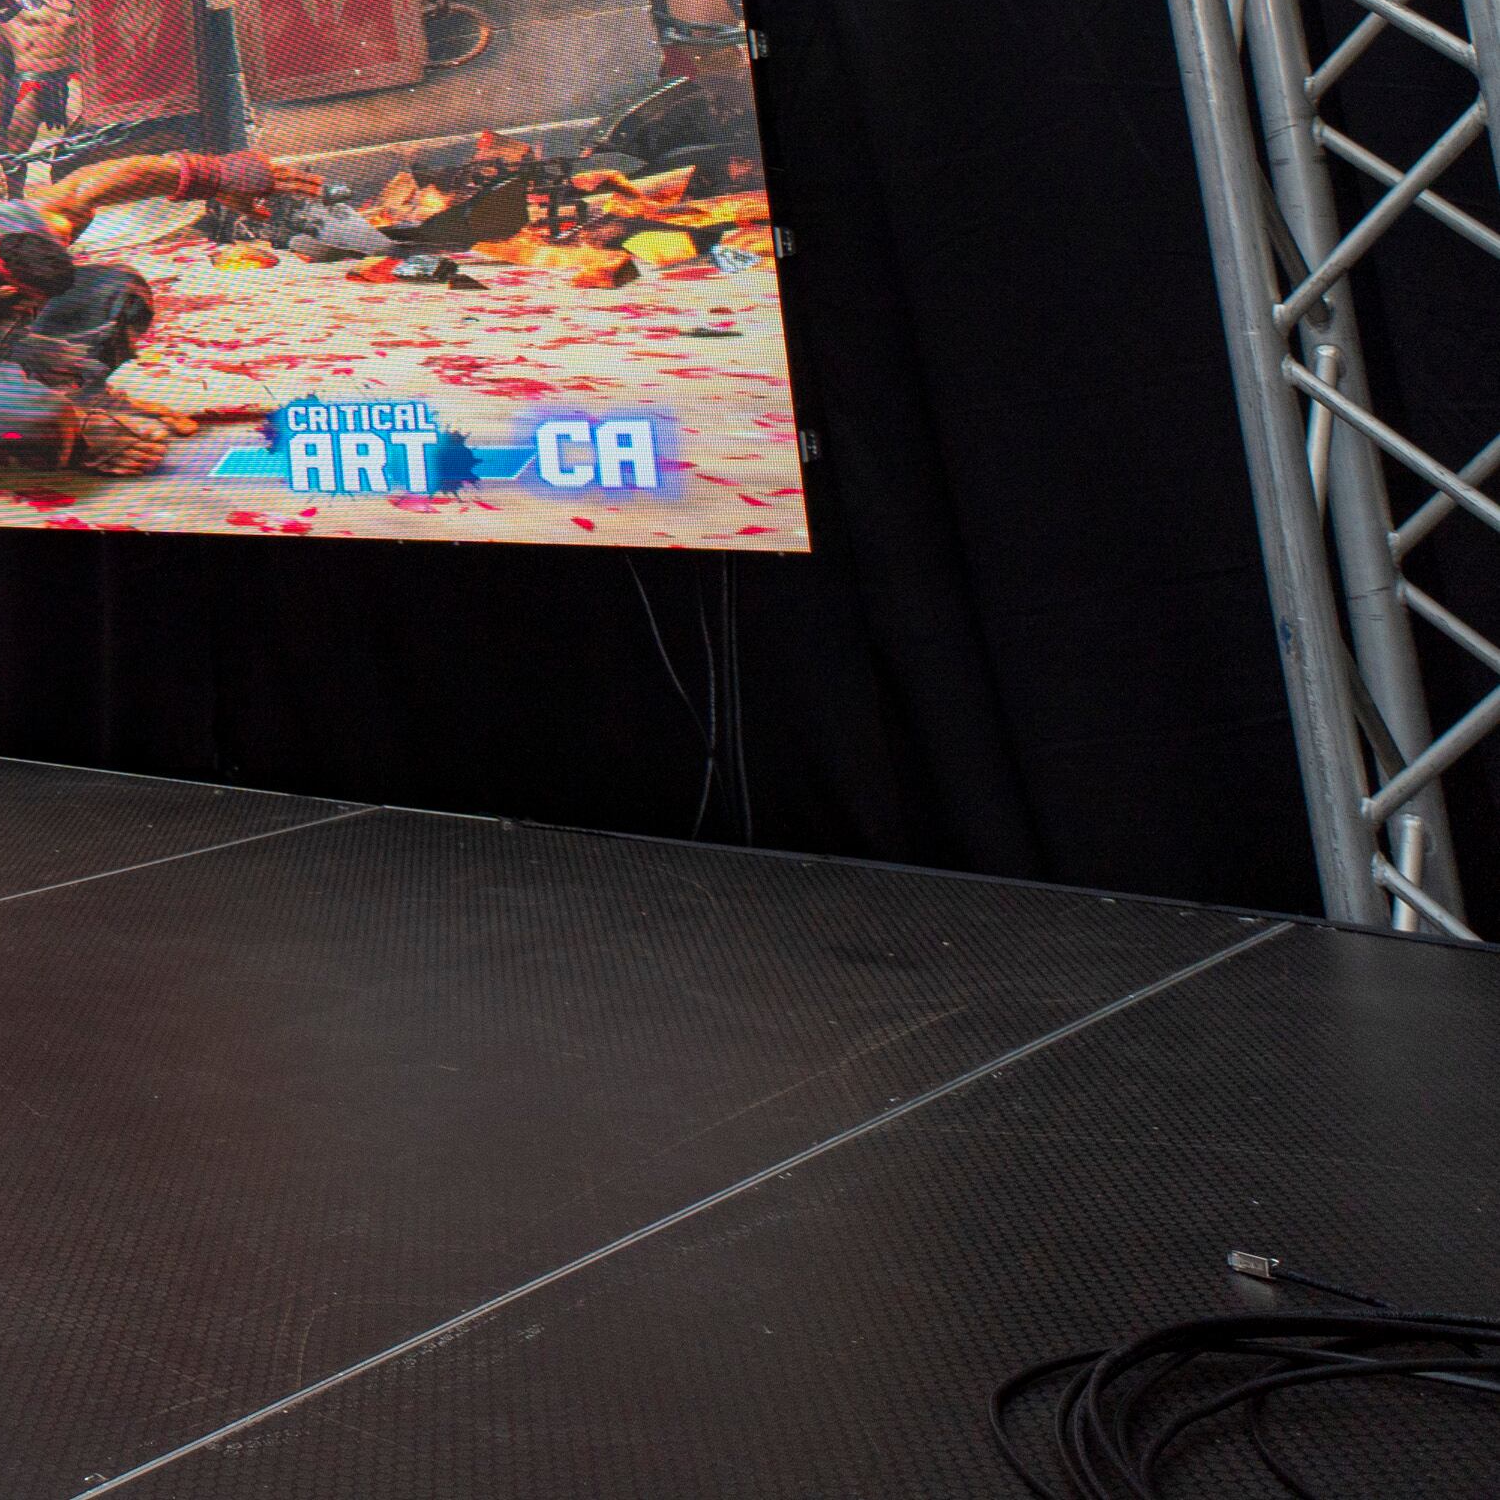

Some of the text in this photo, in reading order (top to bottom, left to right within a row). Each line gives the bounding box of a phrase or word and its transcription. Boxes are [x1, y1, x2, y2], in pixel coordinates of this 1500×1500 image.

[286, 402, 435, 432] CRITICAL
[288, 419, 658, 494] ART CA
